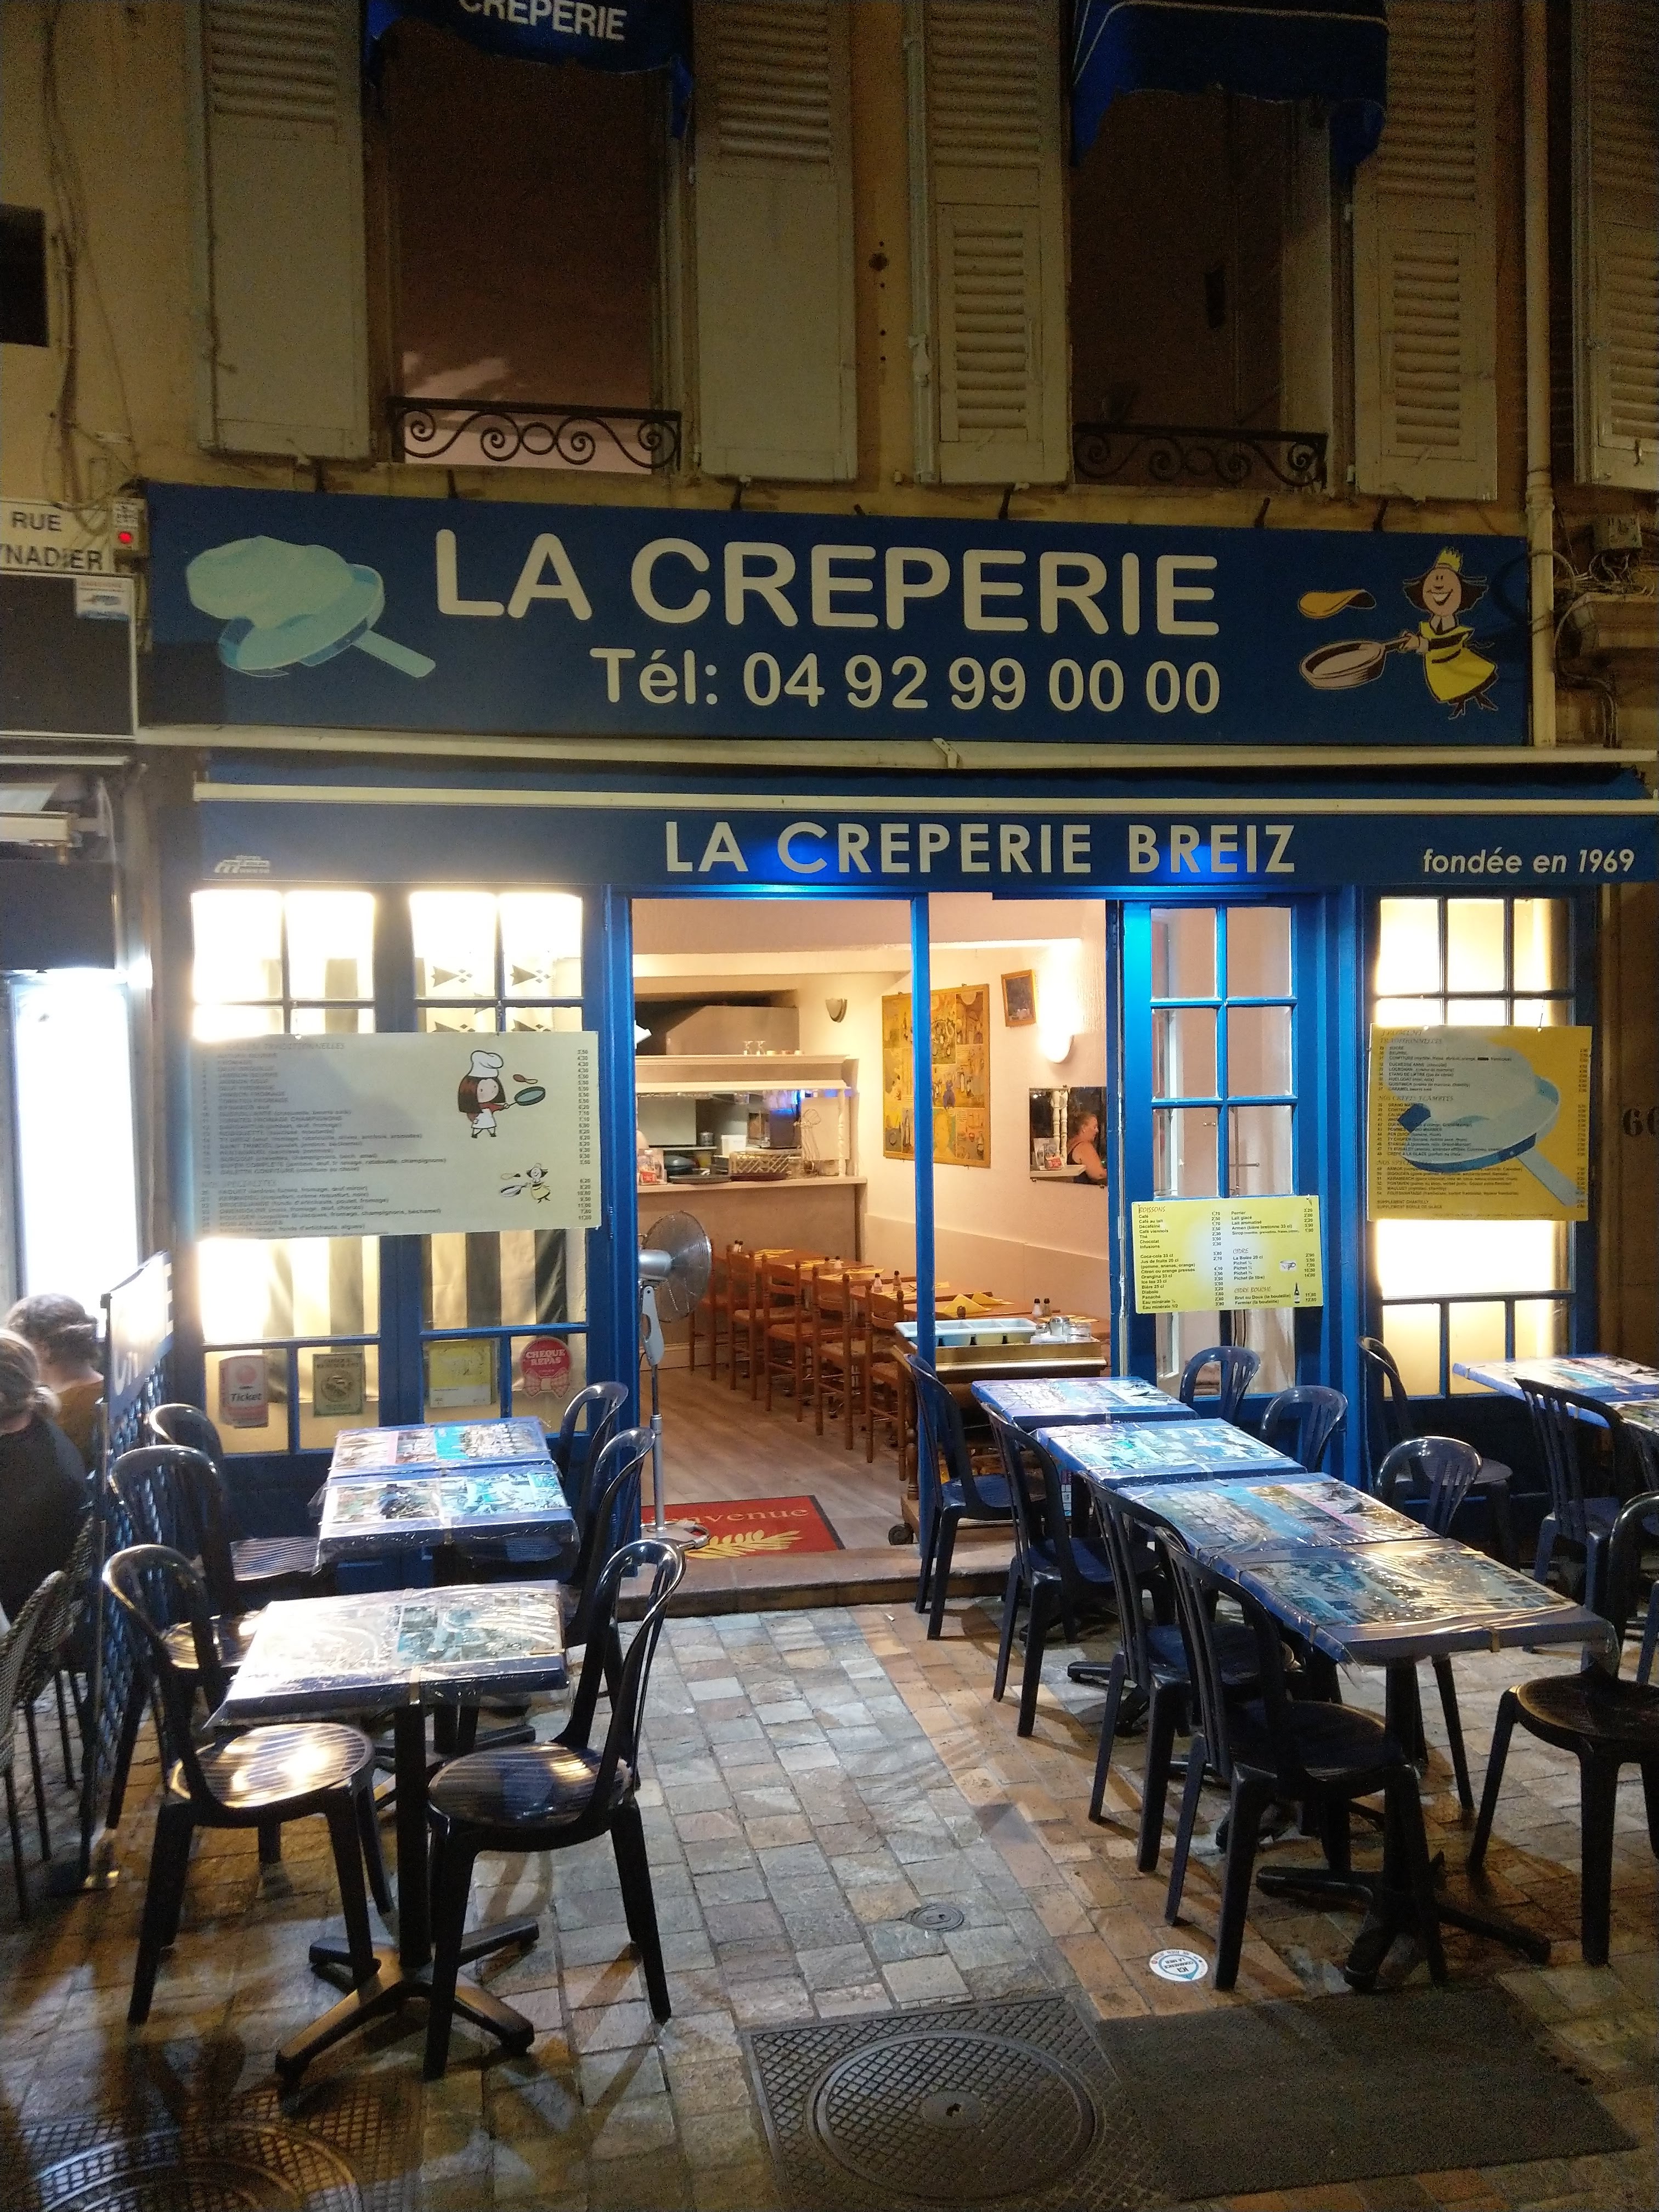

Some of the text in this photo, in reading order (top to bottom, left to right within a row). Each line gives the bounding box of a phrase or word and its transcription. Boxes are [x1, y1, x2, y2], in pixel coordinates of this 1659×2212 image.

[12, 511, 62, 532] RUE
[437, 529, 1220, 635] LA CREPERIE
[590, 647, 1221, 714] Tél: 04 92 99 00 00
[665, 821, 1635, 873] LA CREPERIE BREIZ fondée en 1969
[526, 1349, 566, 1359] CHEQUE
[230, 1393, 262, 1402] Ticket
